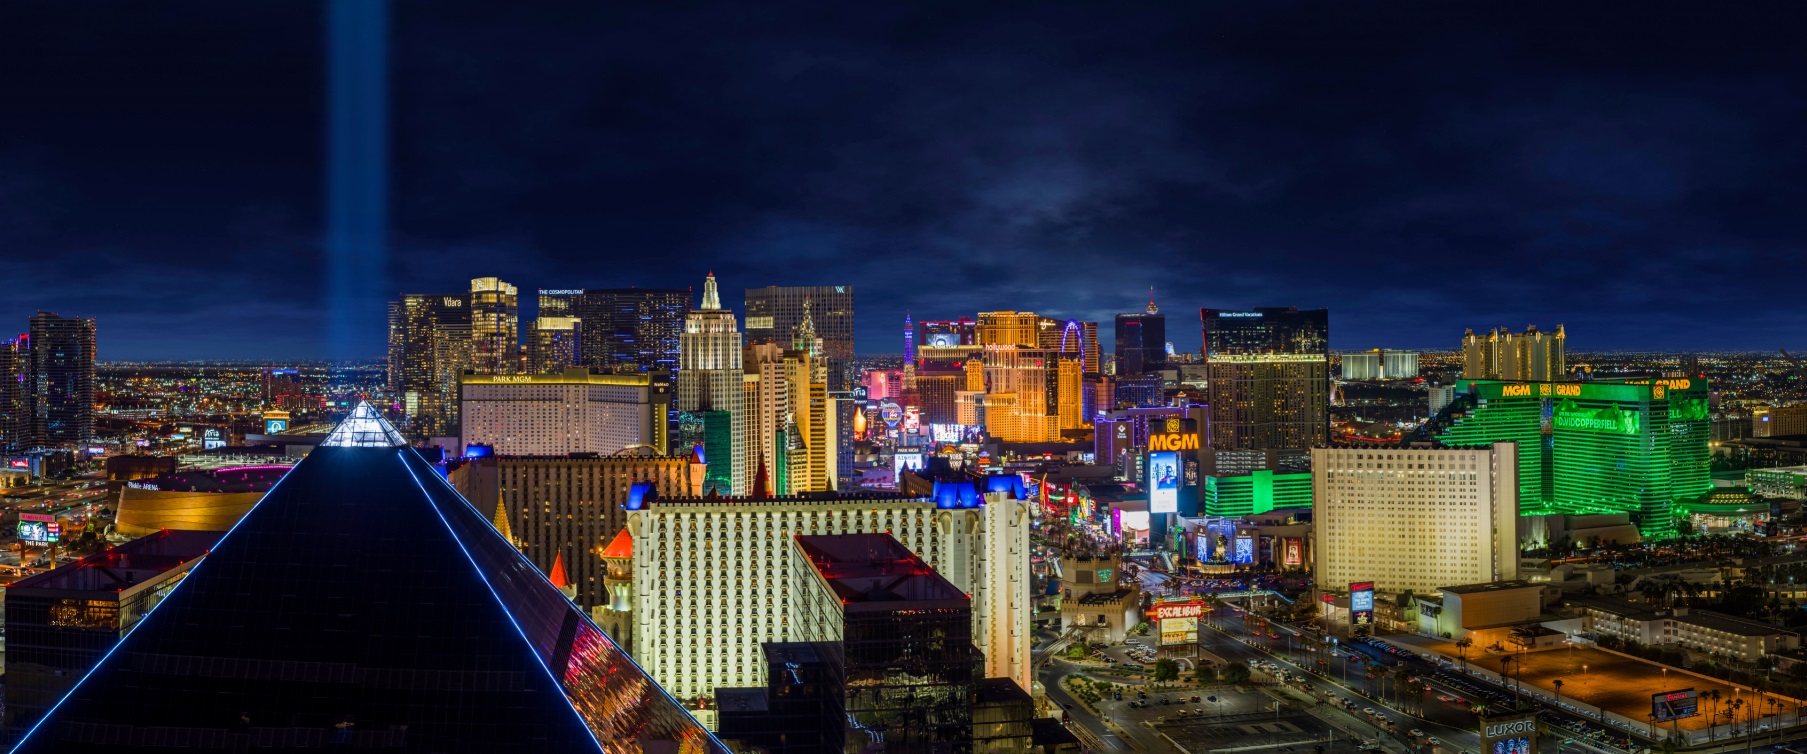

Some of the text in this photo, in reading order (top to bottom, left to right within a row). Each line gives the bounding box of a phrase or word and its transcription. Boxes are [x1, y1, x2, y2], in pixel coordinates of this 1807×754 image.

[443, 297, 462, 307] Vdara
[985, 342, 1016, 353] hollywood
[1502, 384, 1581, 397] MGM GRAND
[1149, 433, 1200, 451] MGM
[143, 483, 159, 491] ARENA
[1159, 605, 1202, 618] EXCALIBUR
[1486, 720, 1536, 738] LUXOR
